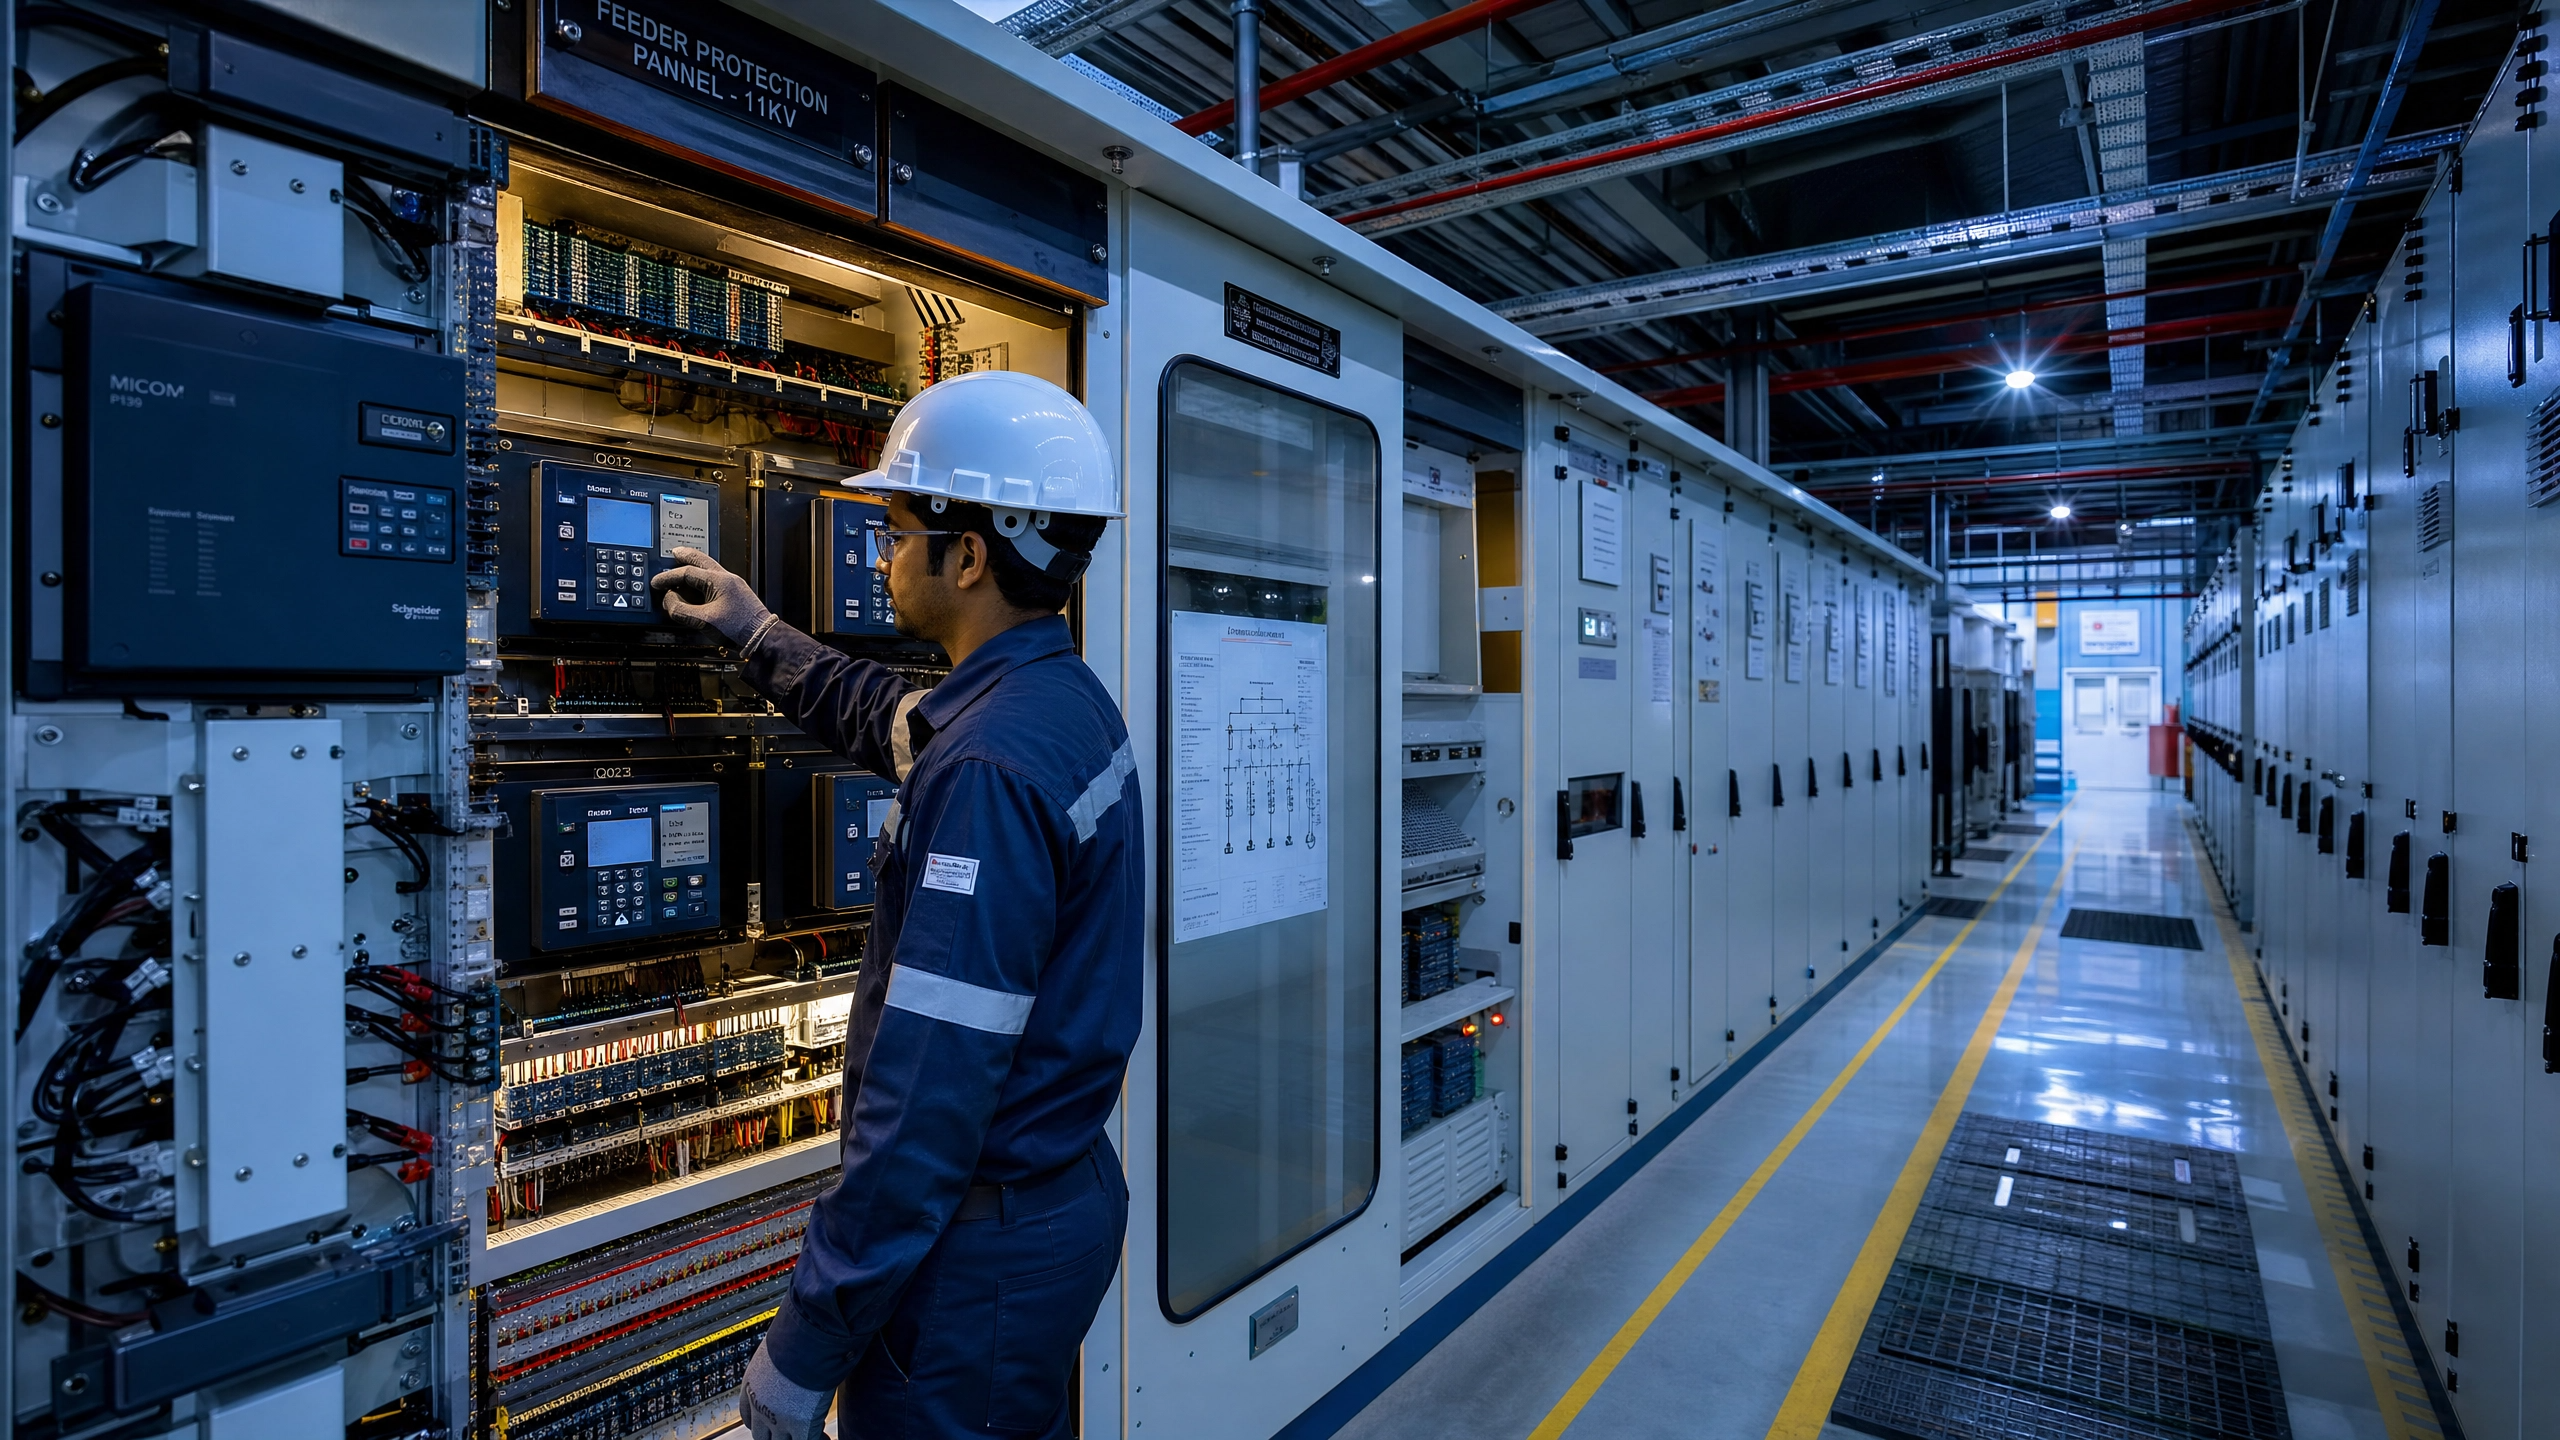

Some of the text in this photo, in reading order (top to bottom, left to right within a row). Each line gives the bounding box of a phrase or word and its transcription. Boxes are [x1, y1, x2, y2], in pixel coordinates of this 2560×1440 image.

[597, 0, 828, 115] FEEDER PROTECTION
[633, 42, 724, 100] PANNEL
[744, 91, 797, 128] 11KV
[109, 373, 185, 399] MICOM
[391, 603, 441, 619] Schneider
